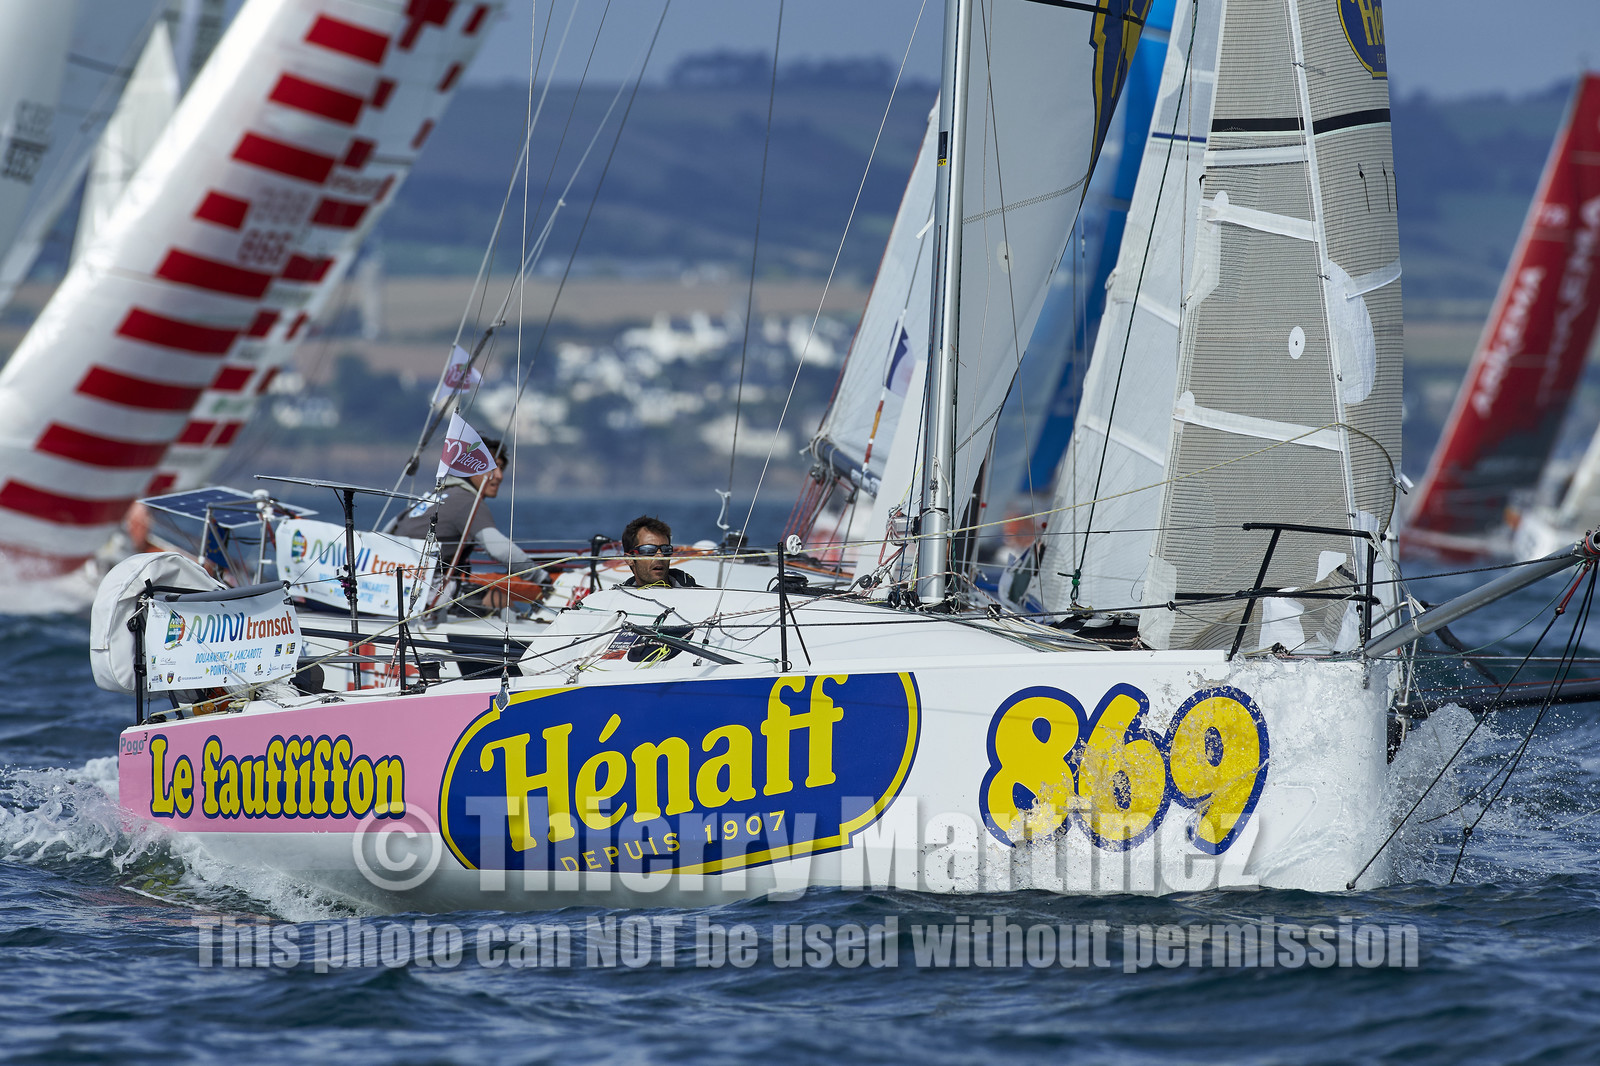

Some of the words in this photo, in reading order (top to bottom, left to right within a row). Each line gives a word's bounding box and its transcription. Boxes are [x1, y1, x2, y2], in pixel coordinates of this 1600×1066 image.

[186, 612, 244, 644] MINI
[246, 610, 295, 641] transat
[233, 647, 263, 660] LANZAROTE
[149, 734, 194, 819] Le
[202, 734, 406, 819] fauffiffon
[480, 674, 848, 852] Hénaff
[979, 682, 1270, 855] 869
[560, 832, 681, 871] DEPUIS
[704, 810, 786, 844] 1907
